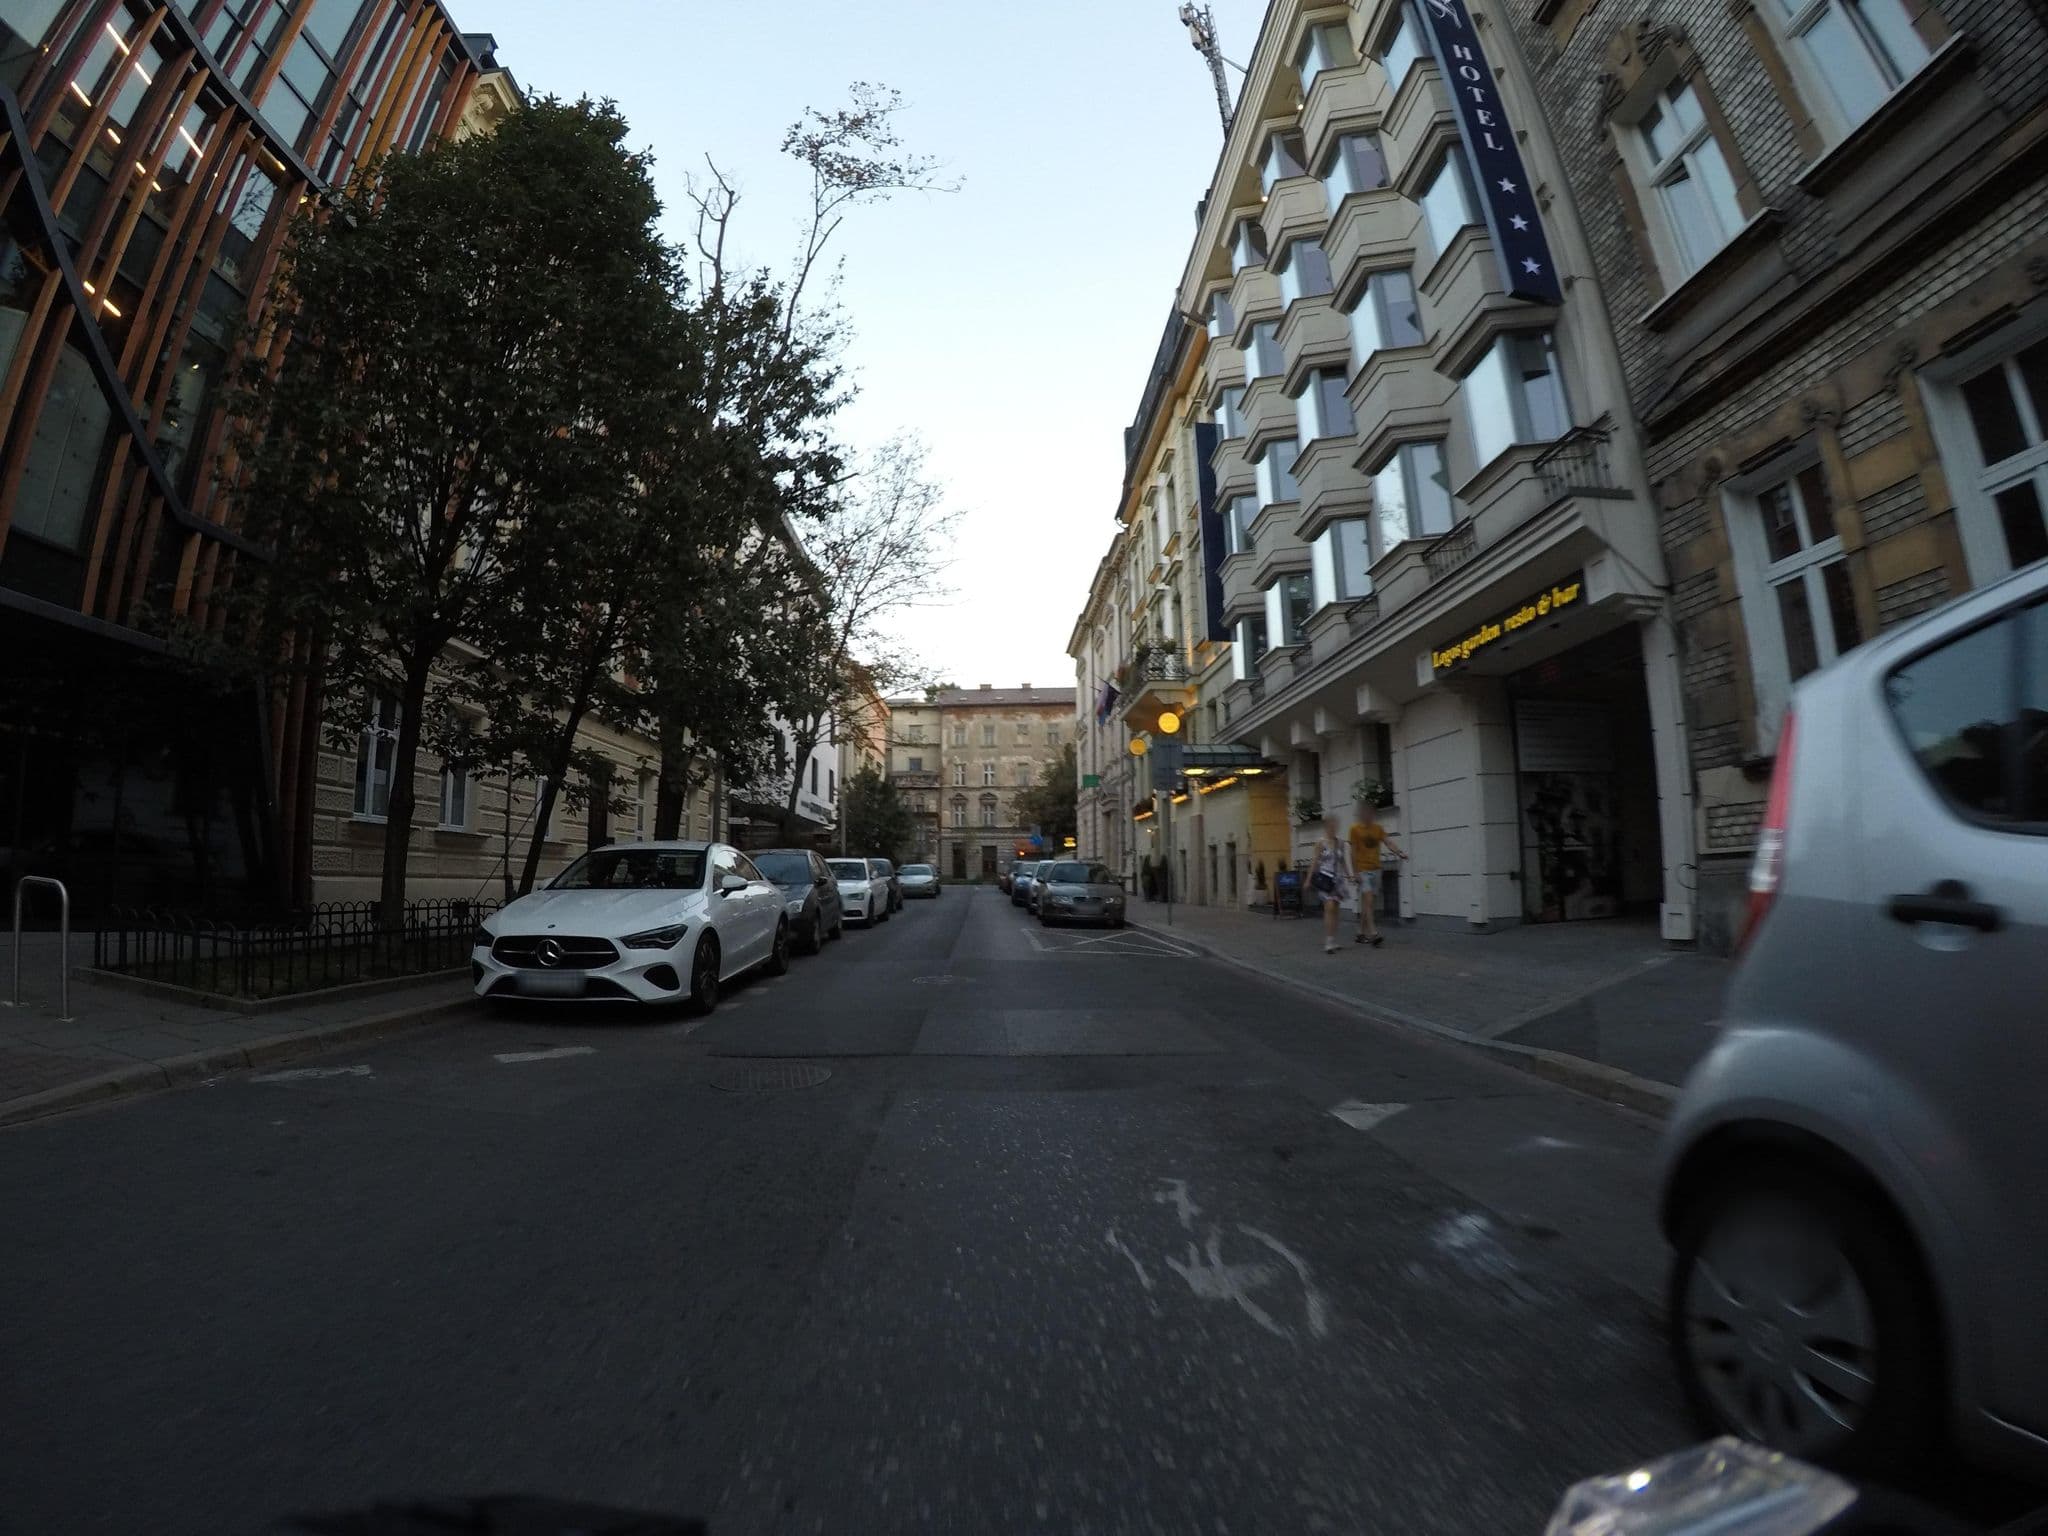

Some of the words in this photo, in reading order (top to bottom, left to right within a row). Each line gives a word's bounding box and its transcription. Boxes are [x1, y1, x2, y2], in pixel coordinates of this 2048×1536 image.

[1452, 44, 1504, 151] HOTEL
[1537, 594, 1552, 616] &
[1552, 584, 1580, 607] bar
